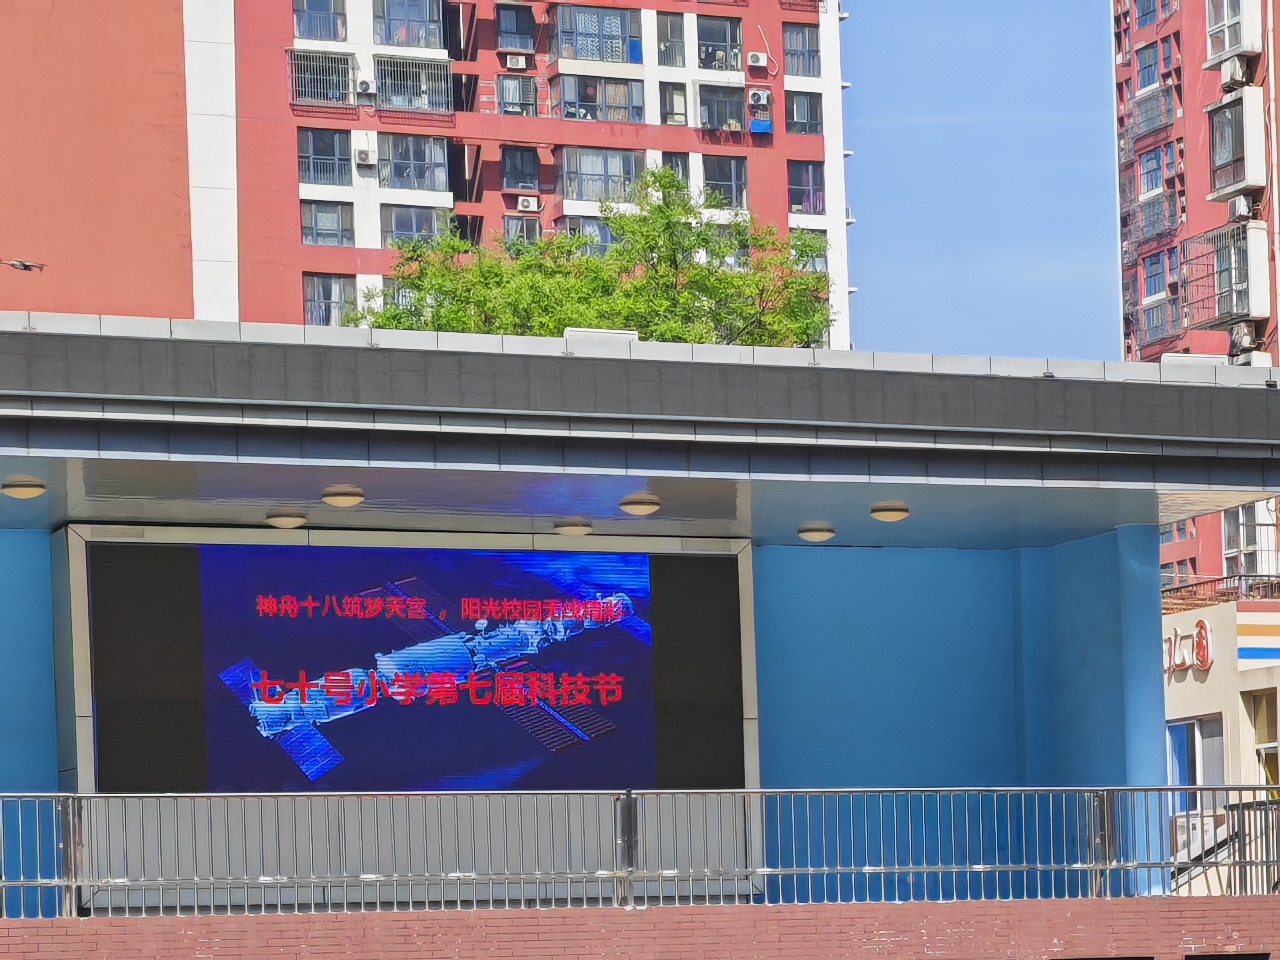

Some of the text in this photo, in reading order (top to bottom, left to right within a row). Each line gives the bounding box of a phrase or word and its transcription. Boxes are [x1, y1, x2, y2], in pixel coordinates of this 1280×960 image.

[252, 670, 625, 707] 七十号小学第七届科技节
